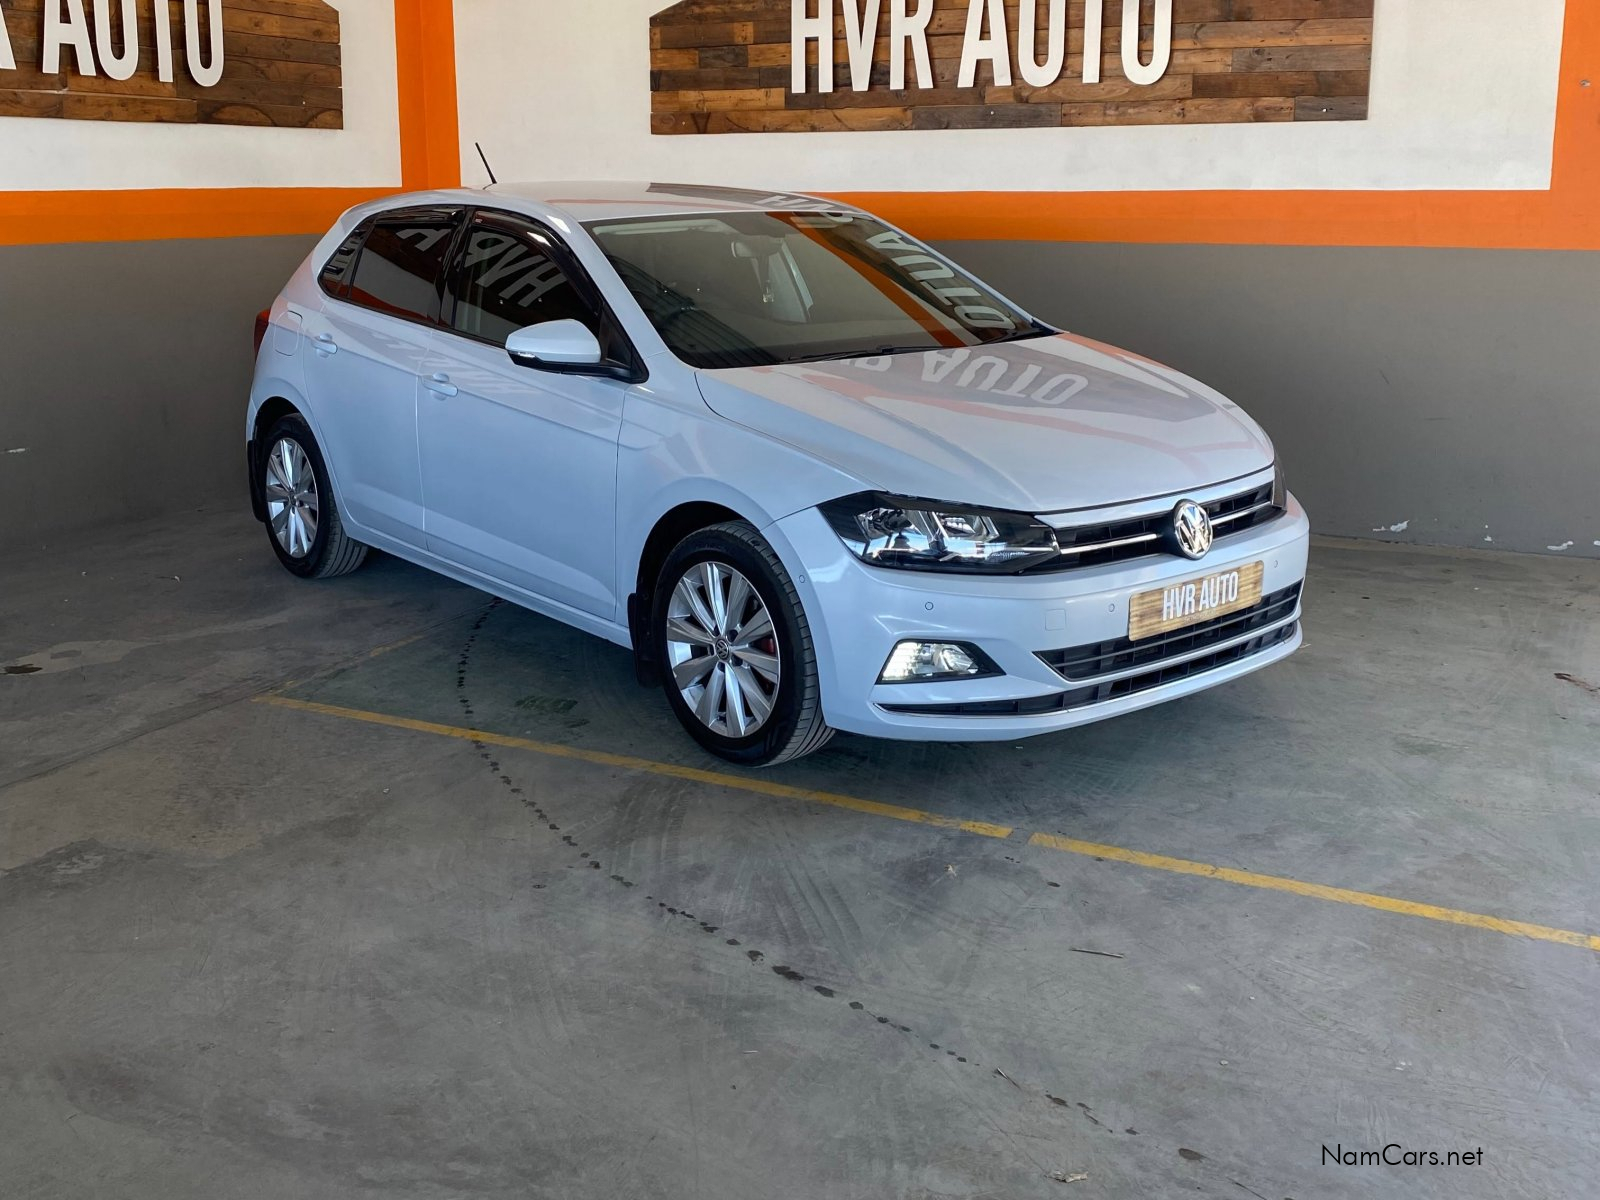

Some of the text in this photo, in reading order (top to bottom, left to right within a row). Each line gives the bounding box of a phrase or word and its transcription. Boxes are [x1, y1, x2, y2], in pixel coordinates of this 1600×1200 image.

[791, 0, 934, 94] HVR
[1162, 583, 1196, 621] HVR
[1199, 571, 1239, 612] AUTO
